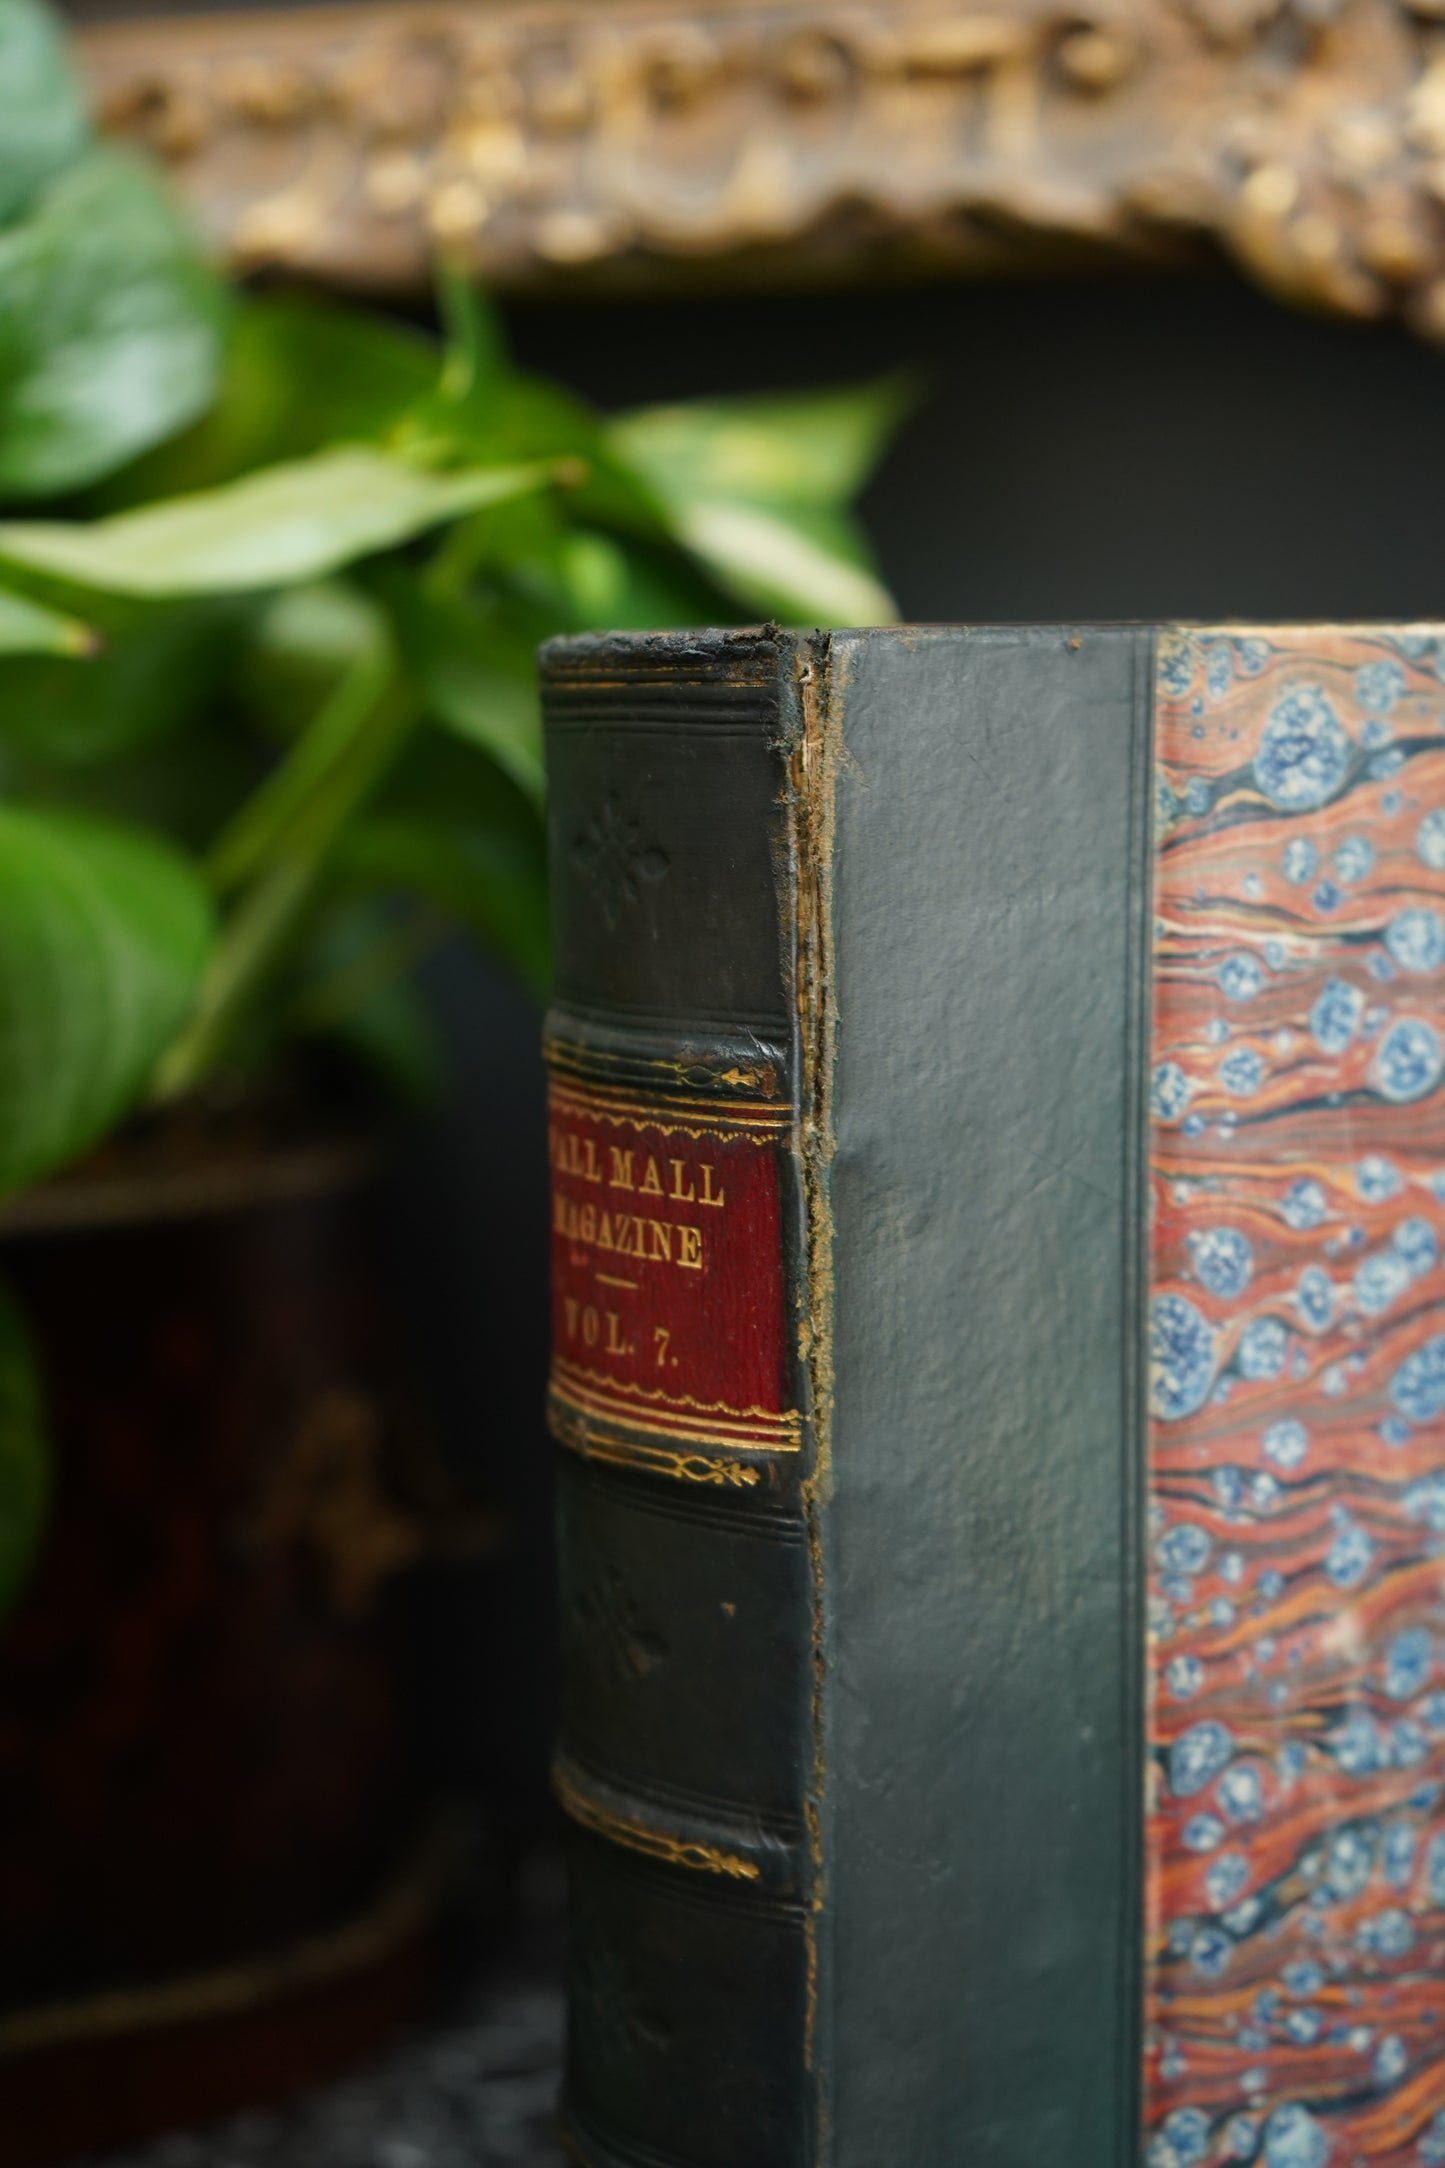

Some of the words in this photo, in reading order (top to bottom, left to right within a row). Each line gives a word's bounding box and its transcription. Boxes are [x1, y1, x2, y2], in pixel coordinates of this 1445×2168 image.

[609, 1145, 725, 1207] MALL
[564, 1297, 635, 1355] VOL.
[653, 1326, 679, 1367] 7.
